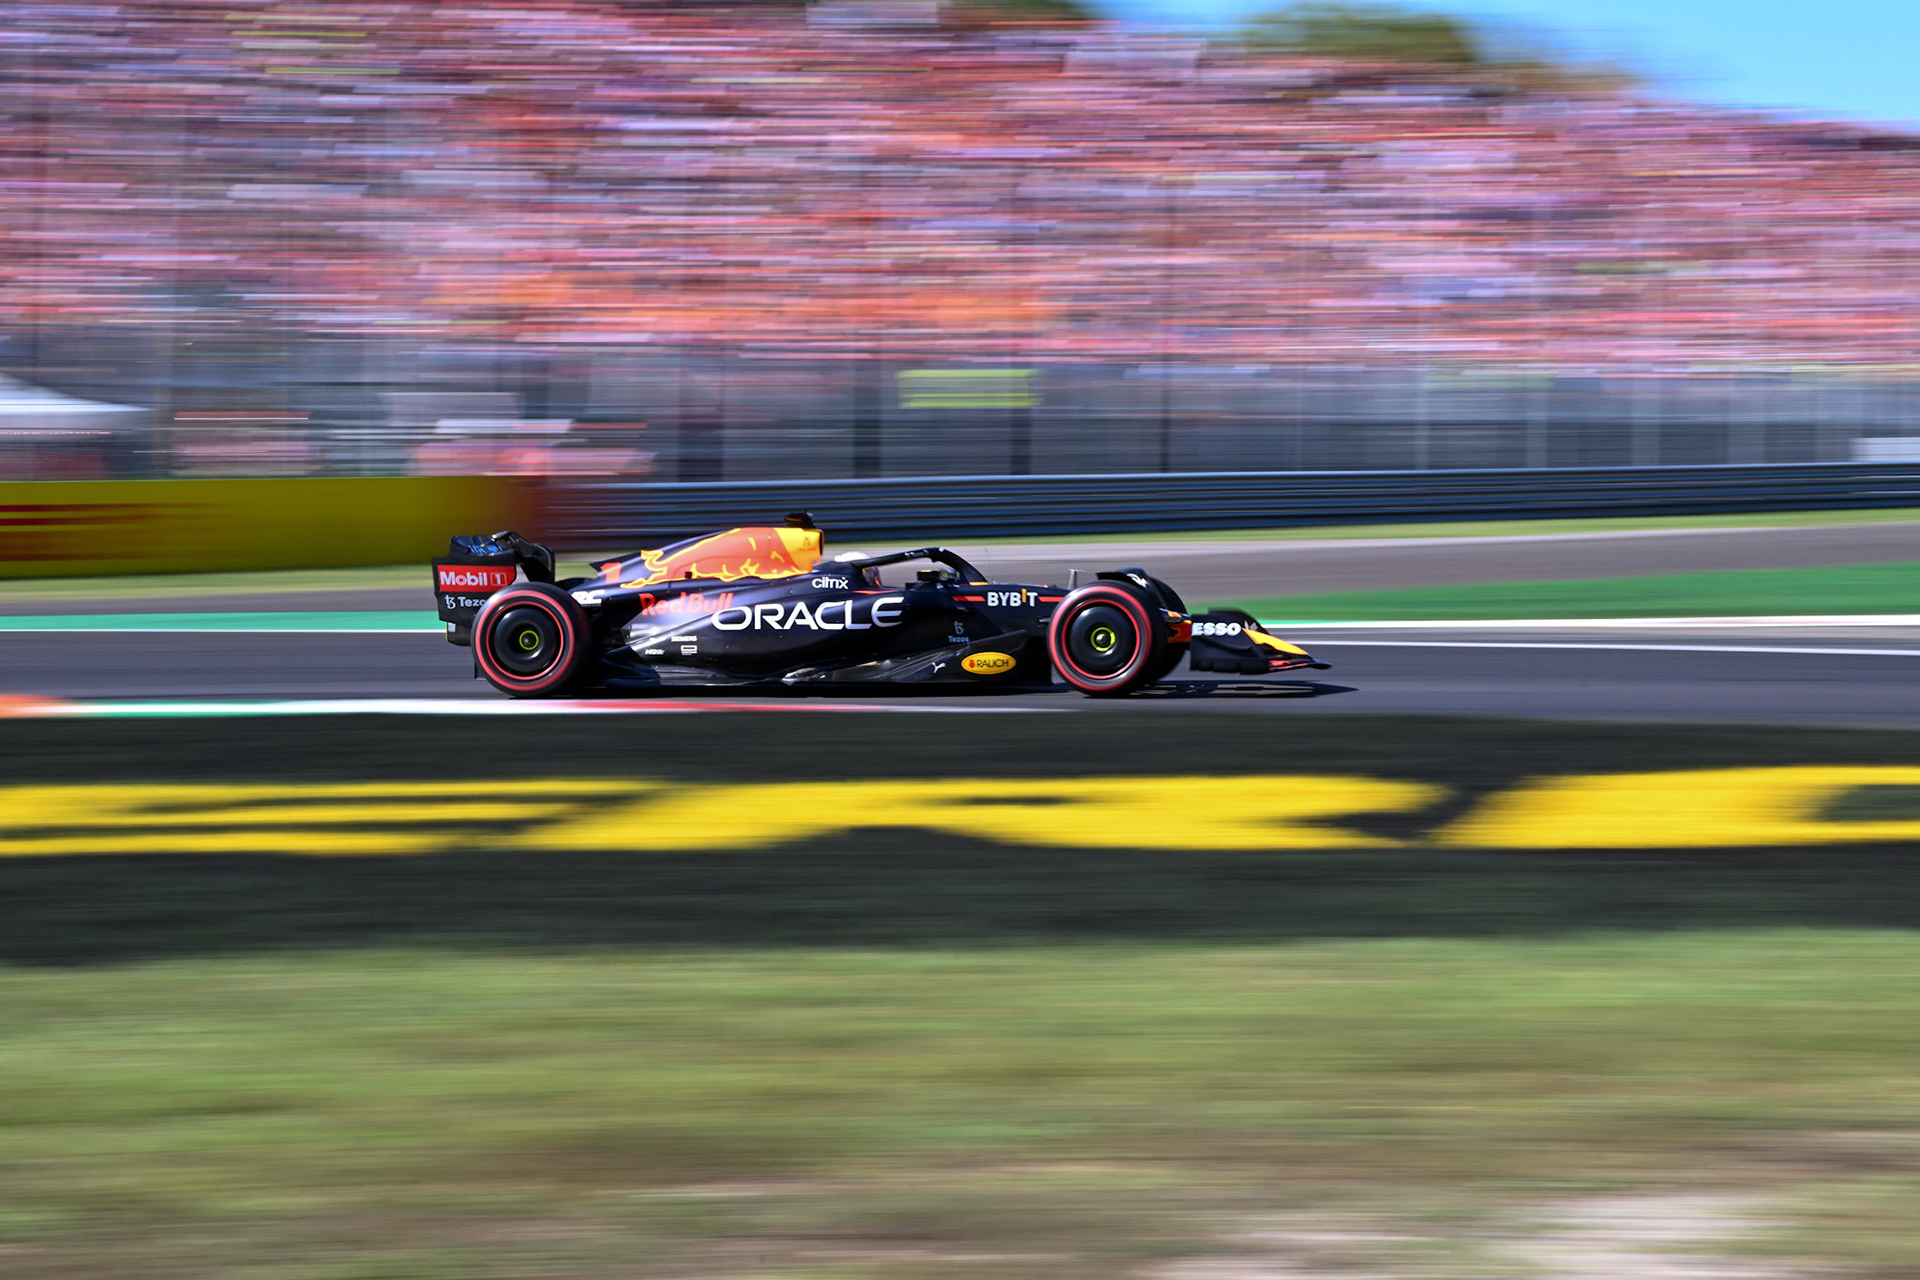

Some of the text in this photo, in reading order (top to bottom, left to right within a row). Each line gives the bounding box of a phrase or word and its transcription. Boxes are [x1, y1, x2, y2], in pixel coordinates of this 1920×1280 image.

[440, 571, 488, 586] Mobil
[600, 562, 622, 584] 1
[639, 592, 734, 616] Red Bull
[987, 588, 1038, 607] BYBIT
[711, 596, 905, 631] ORACLE
[976, 659, 1009, 668] RAUCH
